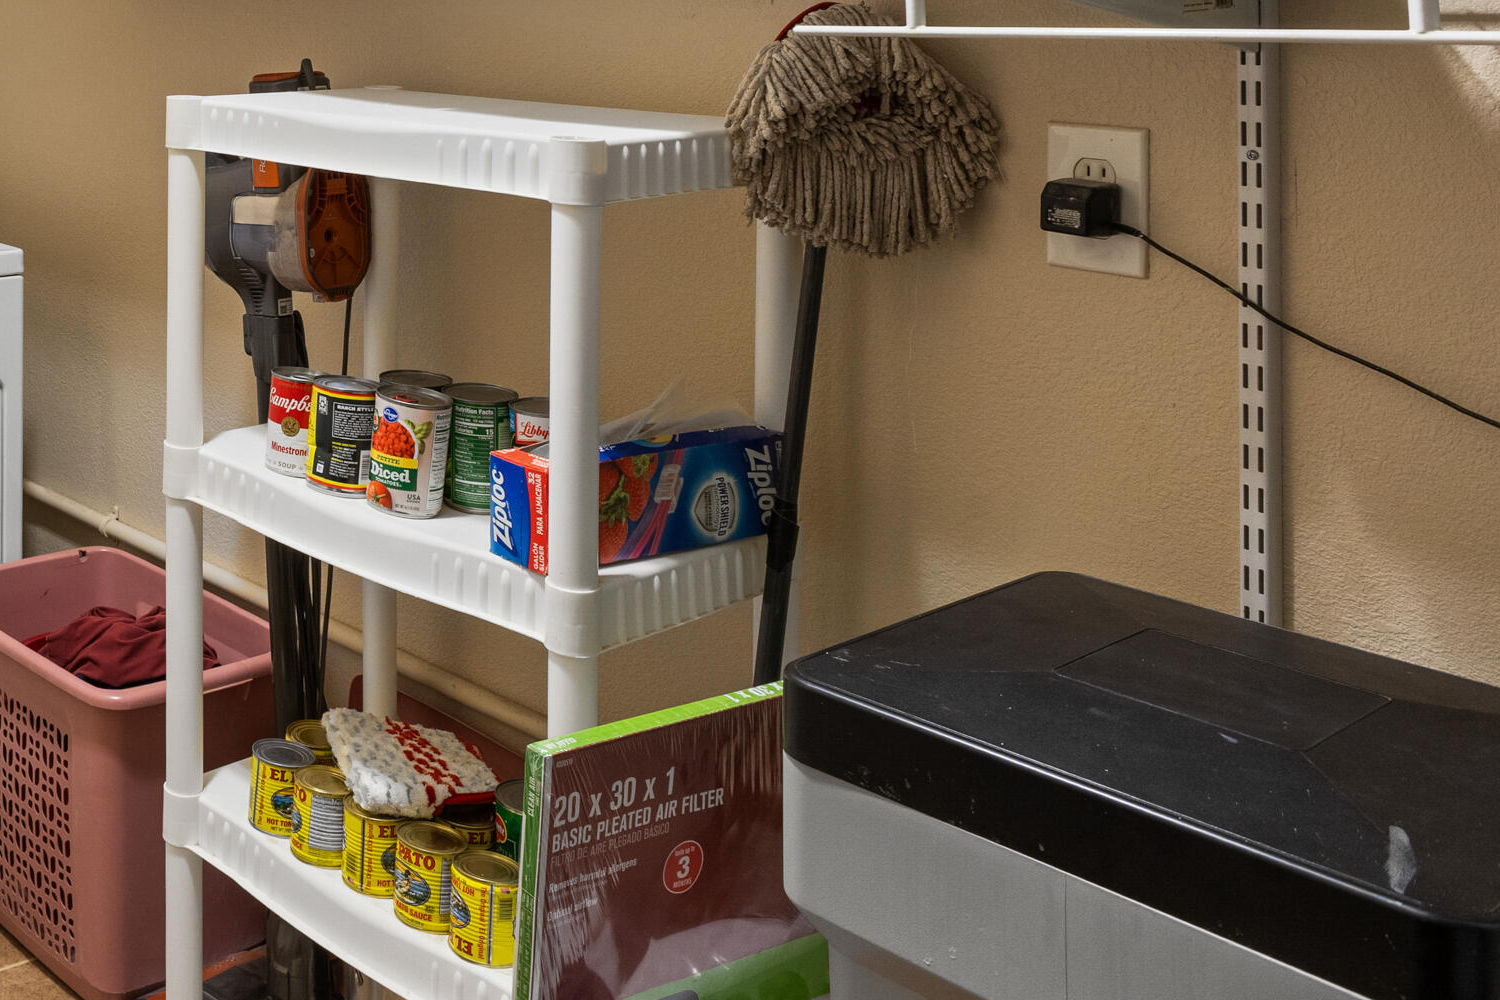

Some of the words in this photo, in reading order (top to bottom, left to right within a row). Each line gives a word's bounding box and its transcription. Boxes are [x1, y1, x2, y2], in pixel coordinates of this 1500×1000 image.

[277, 461, 296, 470] SOUP
[370, 460, 410, 483] Diced
[528, 472, 535, 485] 32
[715, 477, 730, 505] POWER
[745, 445, 777, 526] Ziploc
[535, 474, 544, 516] ALMACENAR
[492, 469, 513, 551] Ziploc
[717, 507, 730, 536] SHIELD
[536, 517, 544, 535] PARA
[269, 768, 288, 783] EL
[527, 791, 535, 817] CLEAN
[553, 791, 581, 828] 20
[588, 792, 602, 818] x
[610, 776, 637, 812] 30
[643, 777, 656, 801] x
[666, 766, 675, 796] 1
[266, 817, 279, 826] HOT
[378, 825, 397, 838] EL
[552, 825, 592, 854] BASIC
[596, 806, 652, 842] PLEATED
[655, 800, 678, 823] AIR
[681, 787, 725, 815] FILTER
[467, 831, 487, 845] EL
[551, 850, 576, 866] FILTRO
[577, 848, 588, 860] DE
[590, 844, 607, 857] AIRE
[608, 830, 642, 850] PLEGADO
[398, 842, 436, 871] PATO
[677, 855, 690, 879] 3
[549, 877, 578, 893] Removes
[579, 867, 606, 883] harmful
[608, 858, 637, 875] allergens
[410, 908, 433, 922] SAUCE
[455, 935, 473, 956] EL
